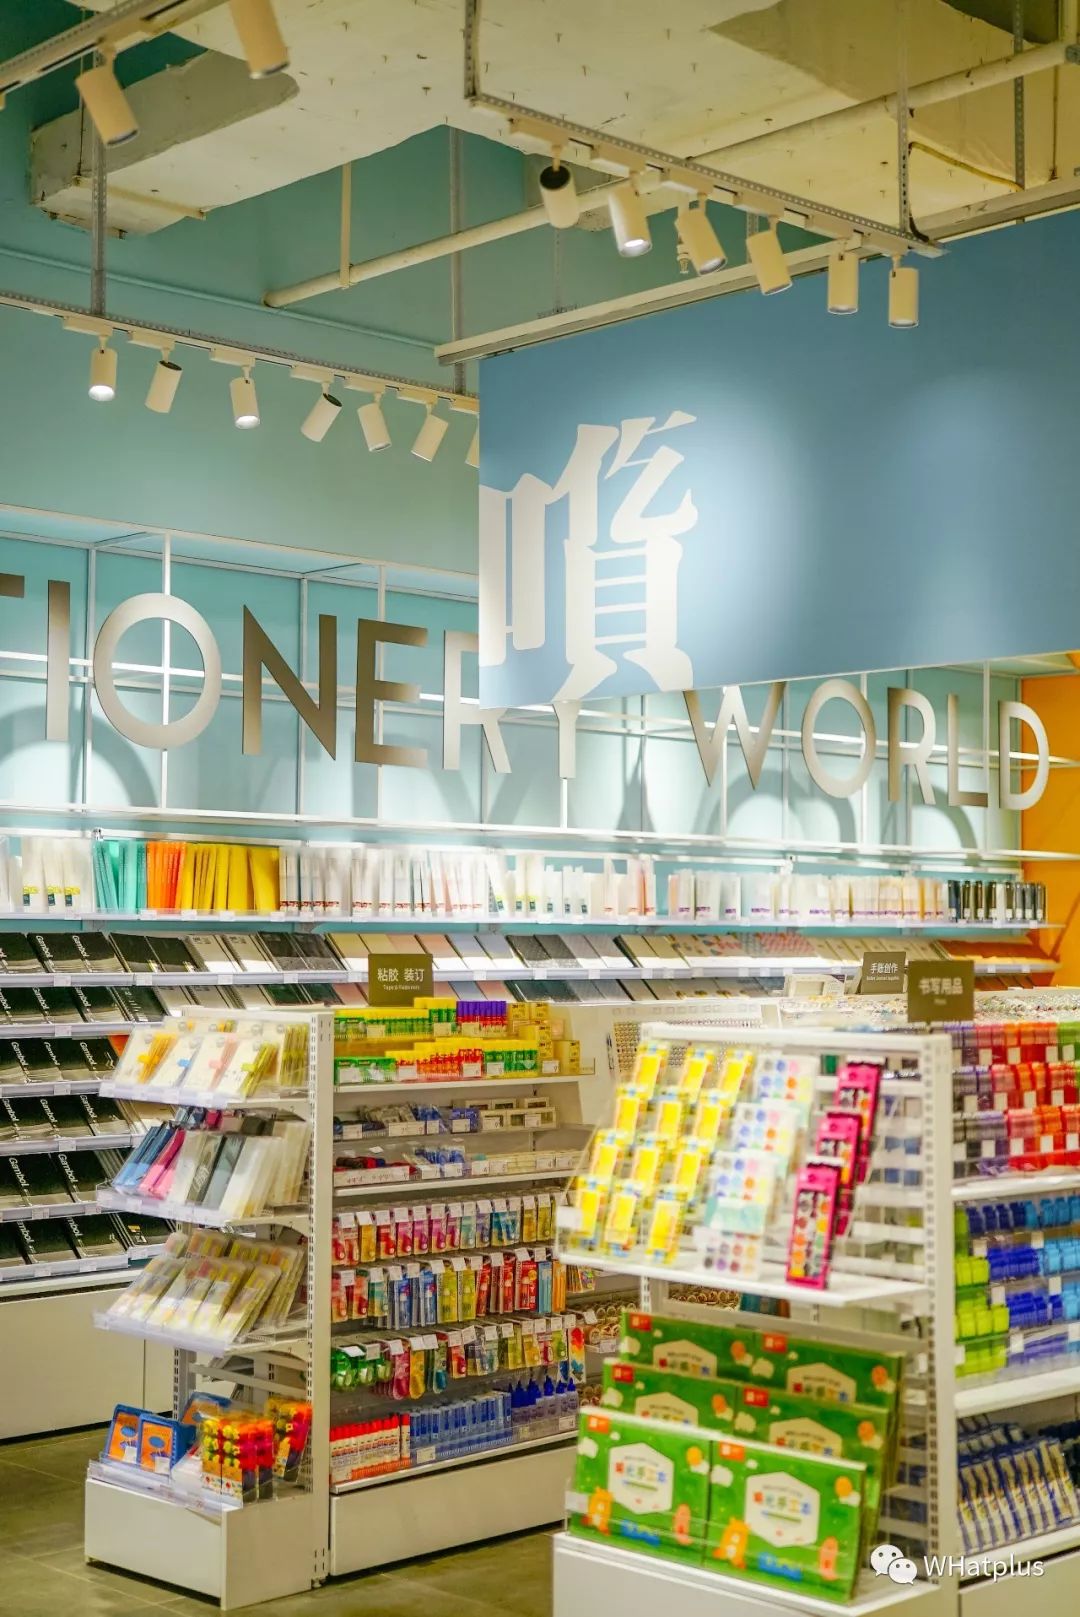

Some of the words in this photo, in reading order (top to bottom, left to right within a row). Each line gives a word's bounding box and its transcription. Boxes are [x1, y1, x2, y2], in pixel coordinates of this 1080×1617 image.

[0, 573, 580, 780] IONERY
[683, 678, 1050, 811] WORLD
[36, 935, 53, 958] Gambol
[72, 935, 90, 957] Gambol
[377, 967, 399, 982] 粘胶
[403, 967, 425, 982] 装订
[918, 977, 963, 995] 书写用品
[11, 1041, 28, 1066] Gambol
[80, 1041, 98, 1065] Gambol
[40, 1099, 58, 1123] Gambol
[80, 1094, 98, 1118] Gambol
[8, 1157, 29, 1187] Gambol
[58, 1153, 78, 1183] Gambol
